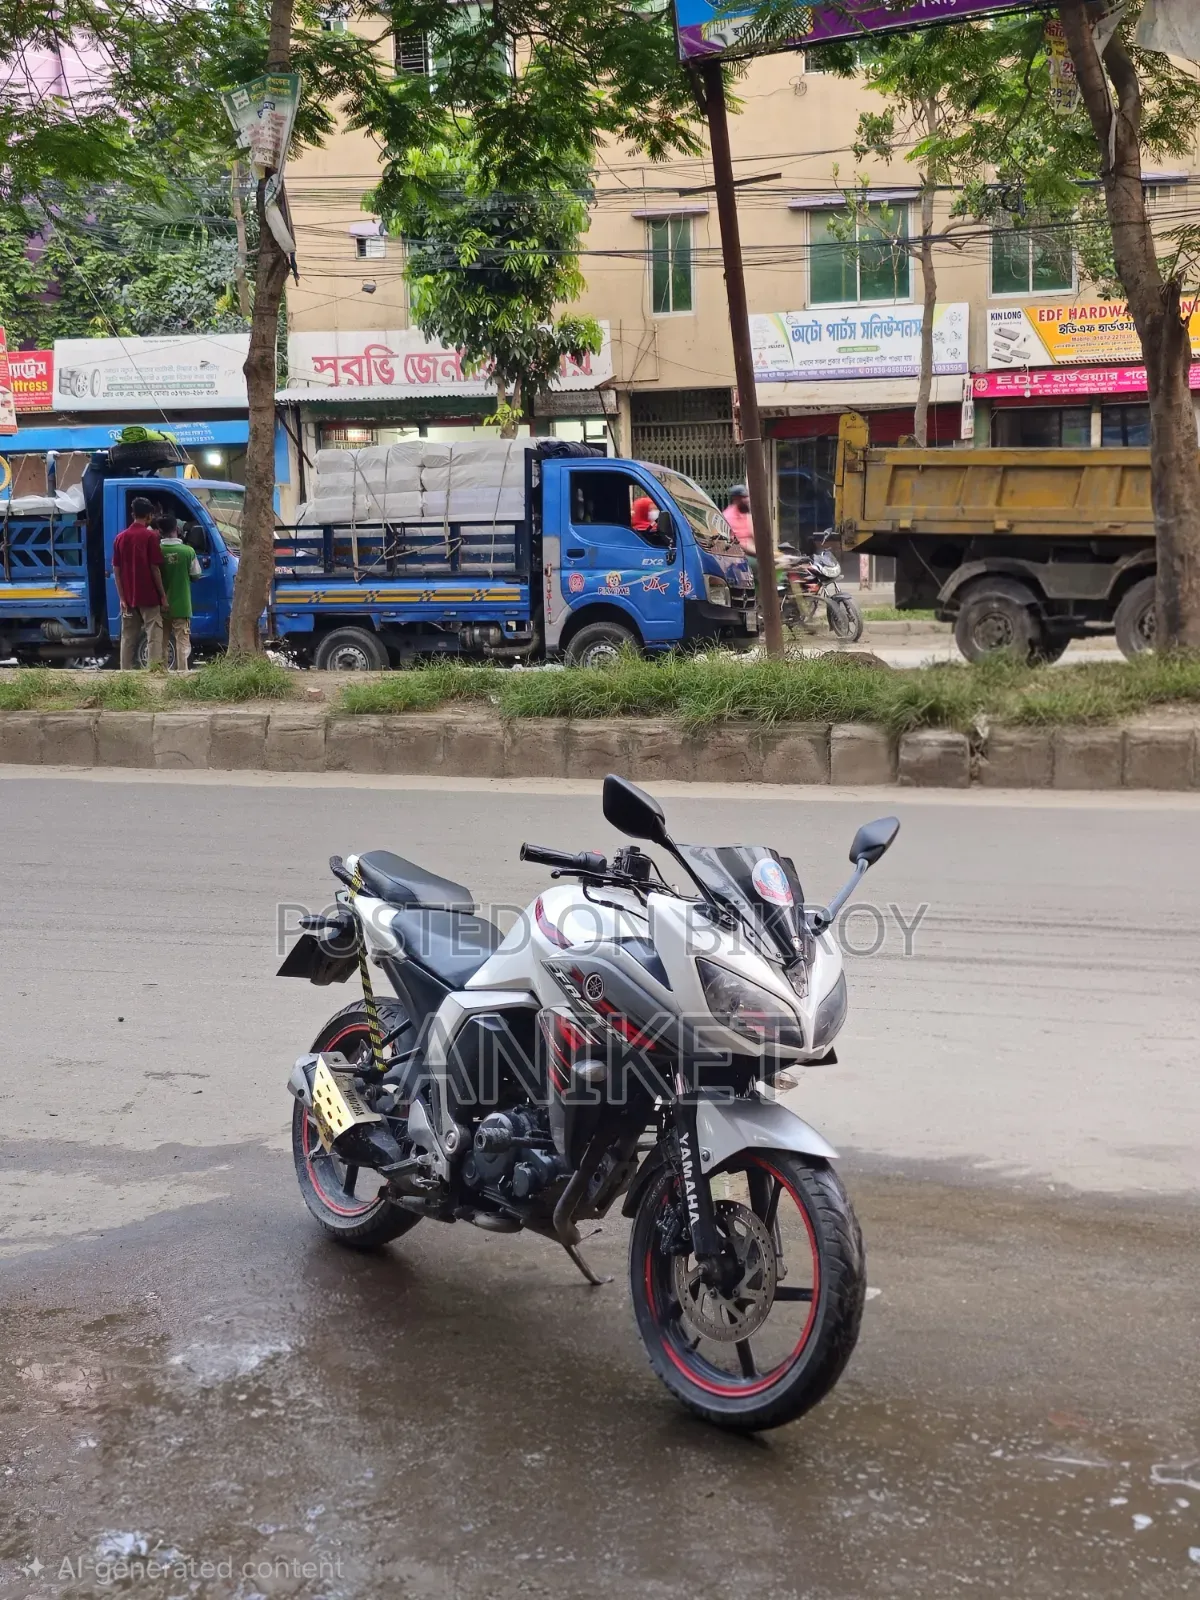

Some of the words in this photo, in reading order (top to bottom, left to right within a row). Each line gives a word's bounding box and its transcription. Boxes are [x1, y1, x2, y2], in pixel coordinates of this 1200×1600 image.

[1003, 311, 1022, 320] LONG
[1038, 308, 1063, 322] EDF
[1068, 303, 1133, 320] HARDWA
[791, 320, 823, 345] অটো
[826, 316, 857, 342] পার্টস
[1058, 323, 1096, 335] ইডিএফ
[312, 343, 399, 387] সুরভি
[996, 374, 1047, 385] EDF
[642, 558, 664, 566] EX2
[679, 1132, 700, 1227] YAMAHA
